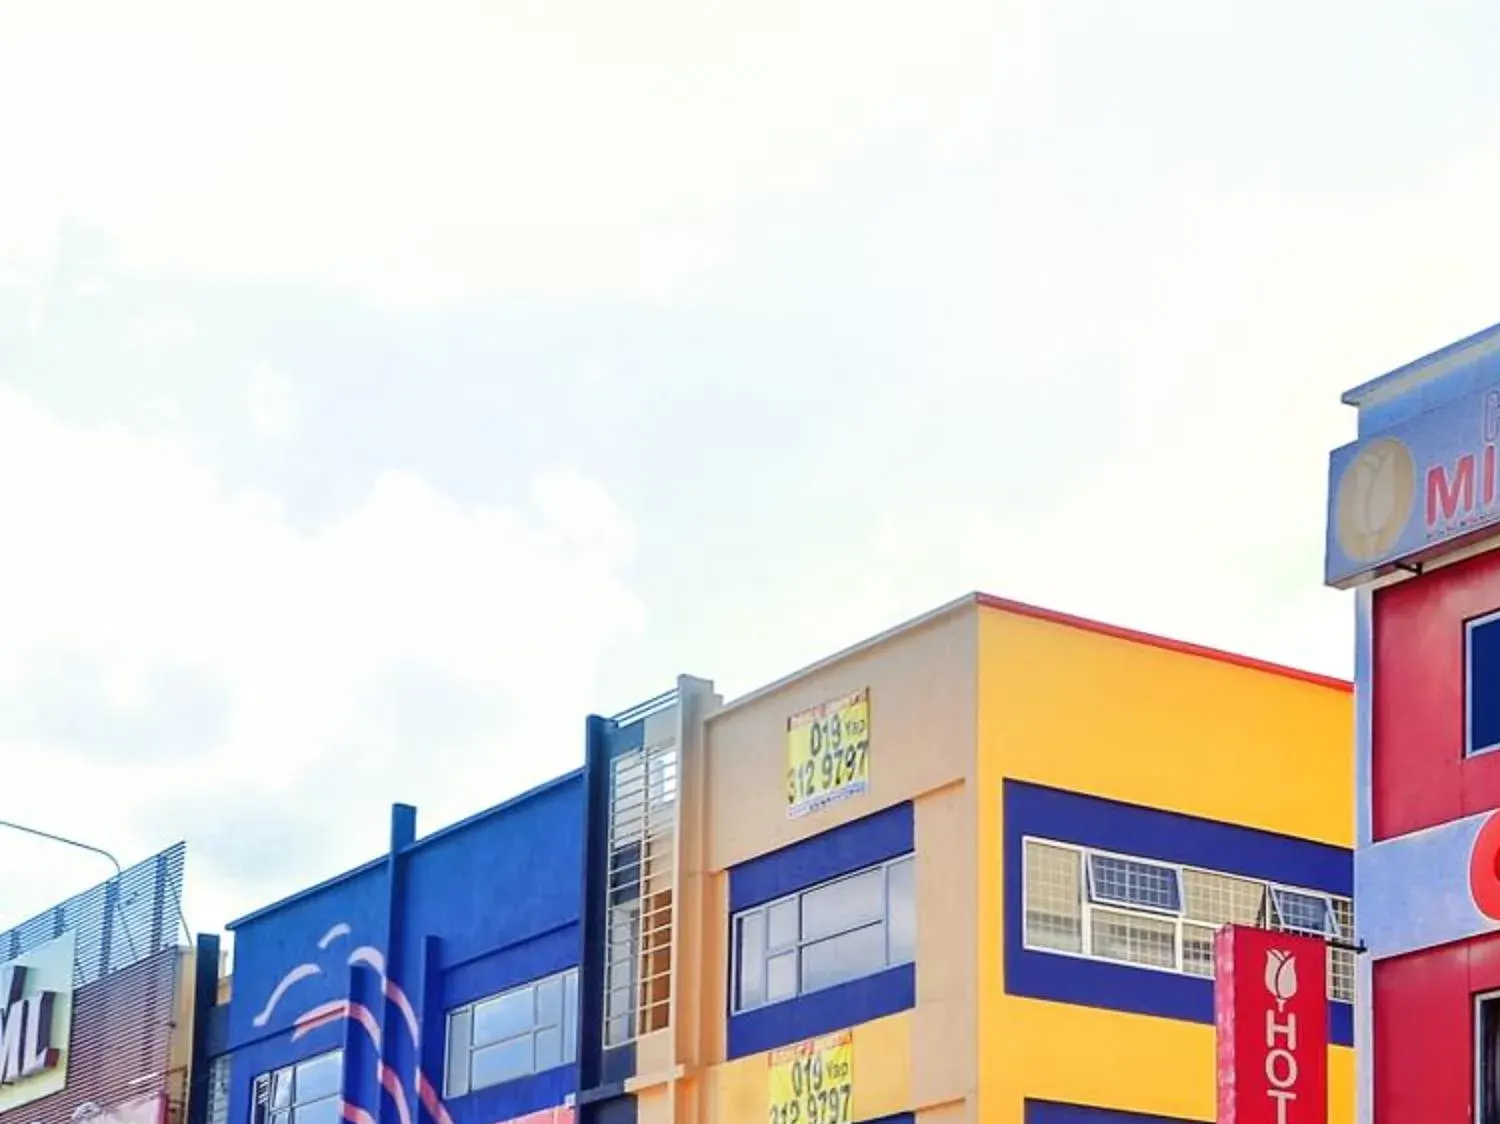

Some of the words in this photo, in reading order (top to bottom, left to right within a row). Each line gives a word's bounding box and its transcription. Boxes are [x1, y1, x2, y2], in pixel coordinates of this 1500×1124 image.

[810, 713, 840, 757] 019
[821, 740, 868, 790] 9797
[791, 1056, 823, 1097] 019
